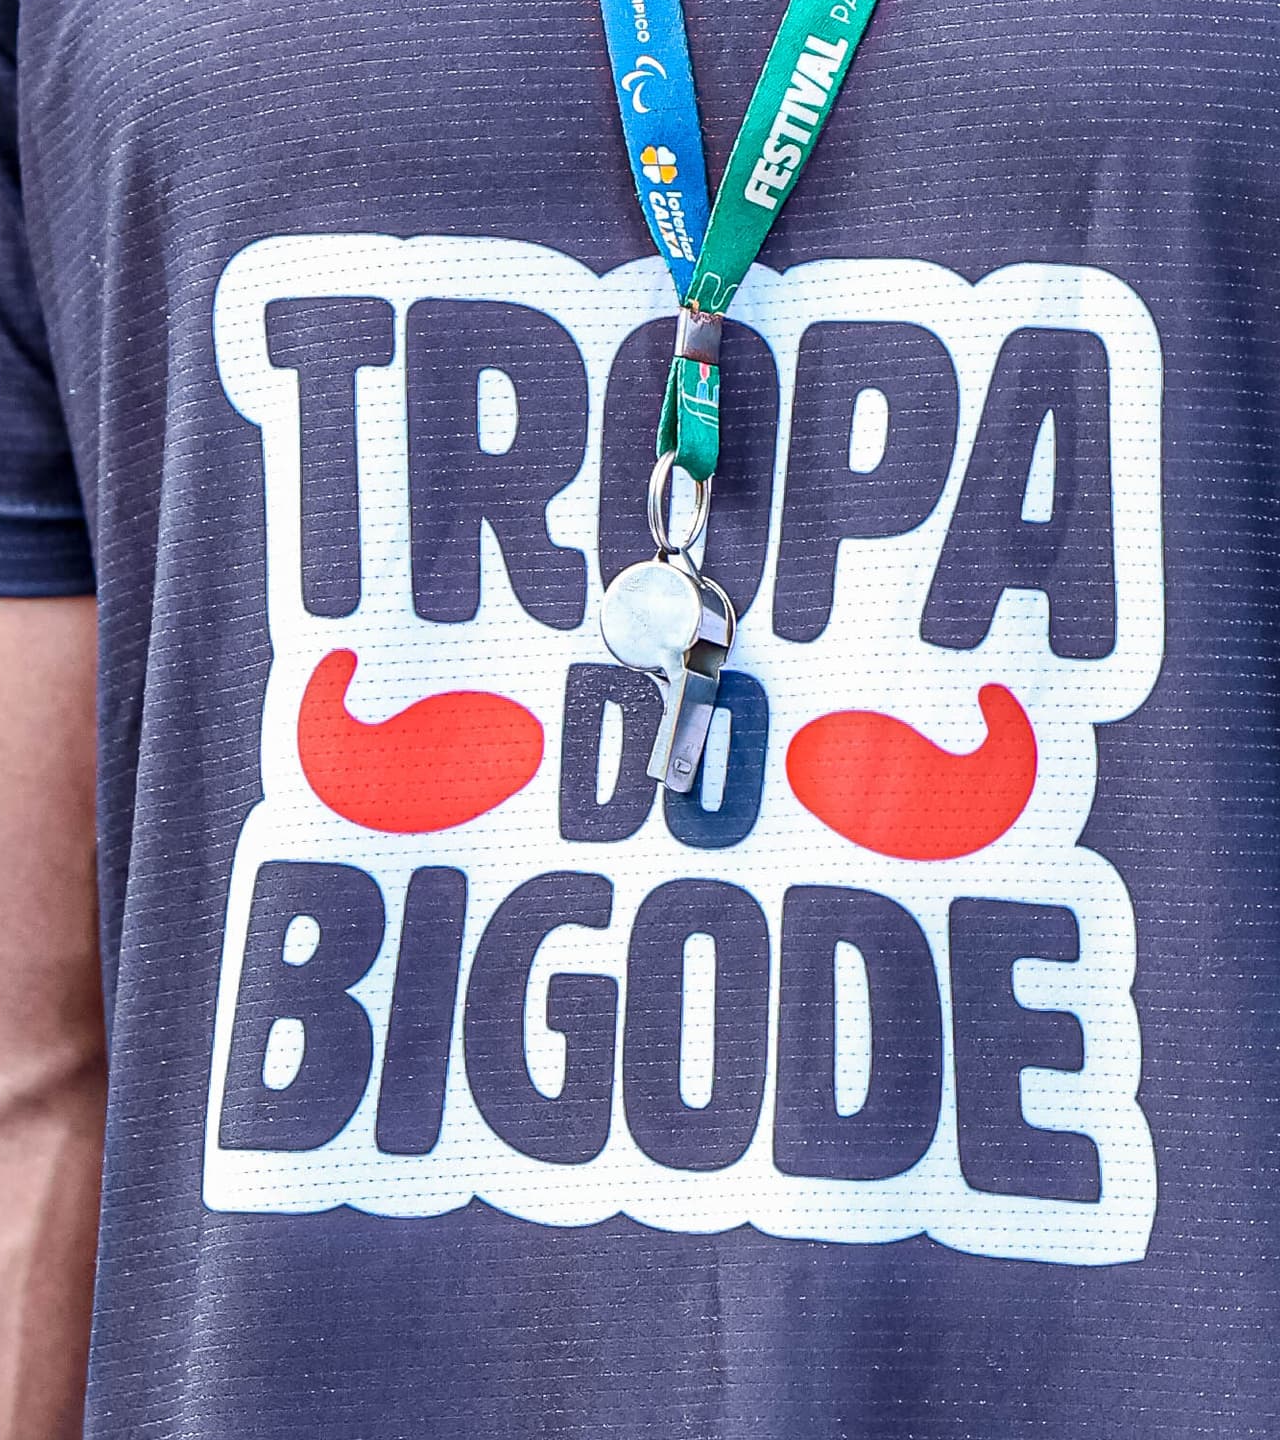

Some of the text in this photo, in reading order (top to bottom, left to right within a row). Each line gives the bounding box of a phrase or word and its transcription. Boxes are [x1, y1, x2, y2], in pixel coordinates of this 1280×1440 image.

[744, 34, 849, 210] FESTIVAL
[649, 191, 684, 258] CAIXA
[666, 191, 696, 262] loterias
[265, 297, 1118, 660] TROPA
[558, 663, 769, 848] DO
[217, 860, 1102, 1204] BIGODE
